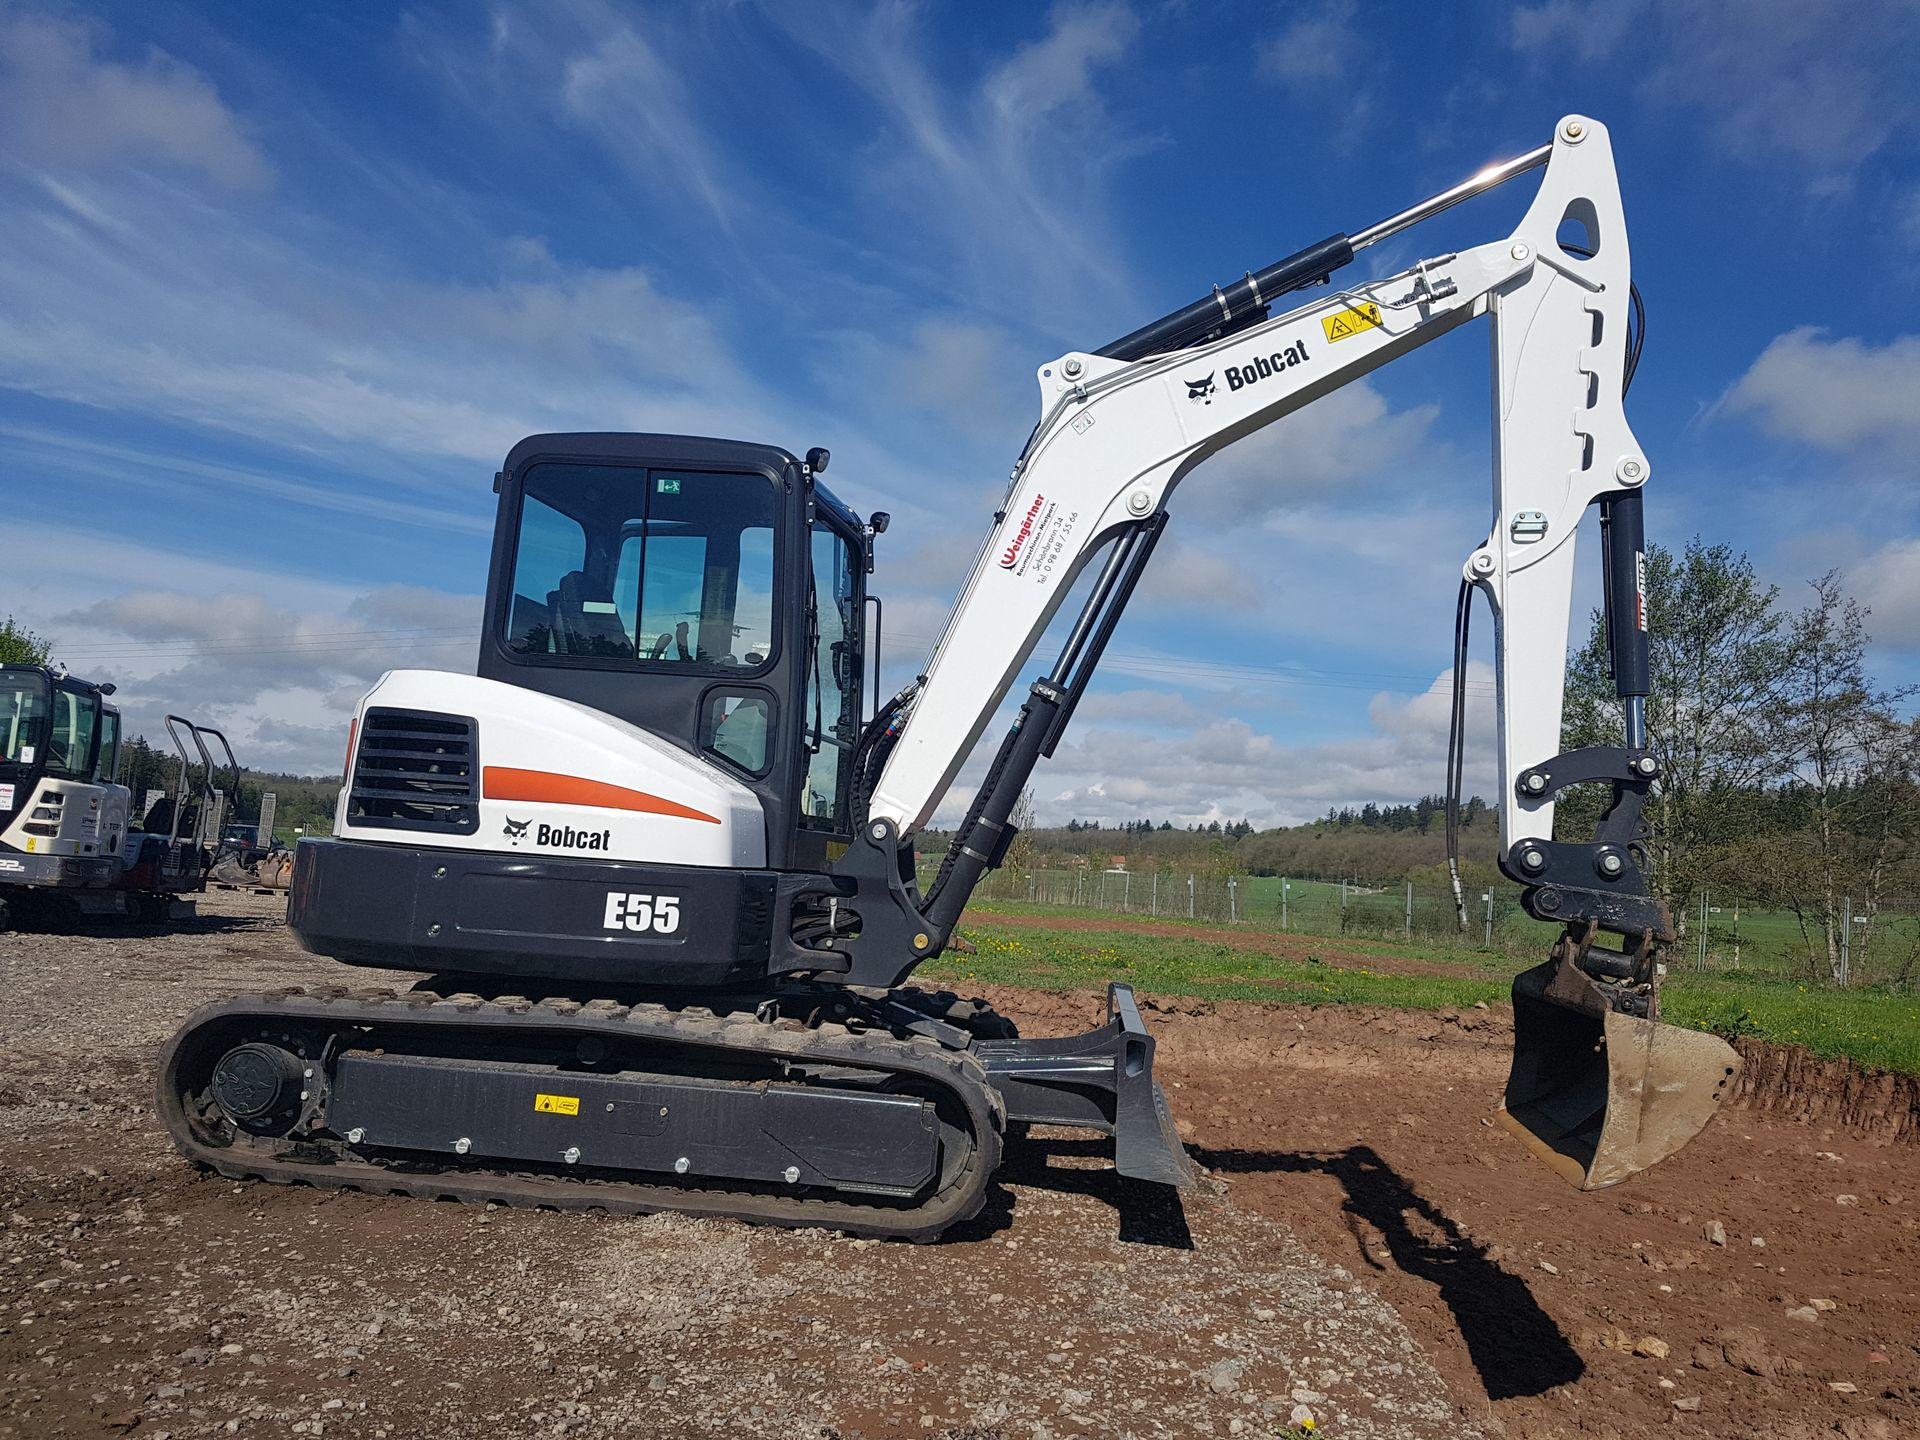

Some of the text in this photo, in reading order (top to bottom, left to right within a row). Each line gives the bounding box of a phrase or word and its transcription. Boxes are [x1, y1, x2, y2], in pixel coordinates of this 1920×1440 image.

[1224, 339, 1310, 392] Bobcat
[1001, 494, 1044, 565] Weingärtner
[1054, 517, 1064, 528] 34
[1063, 524, 1073, 535] 55
[1070, 512, 1079, 523] 66
[537, 824, 611, 851] Bobcat
[603, 892, 680, 934] E55
